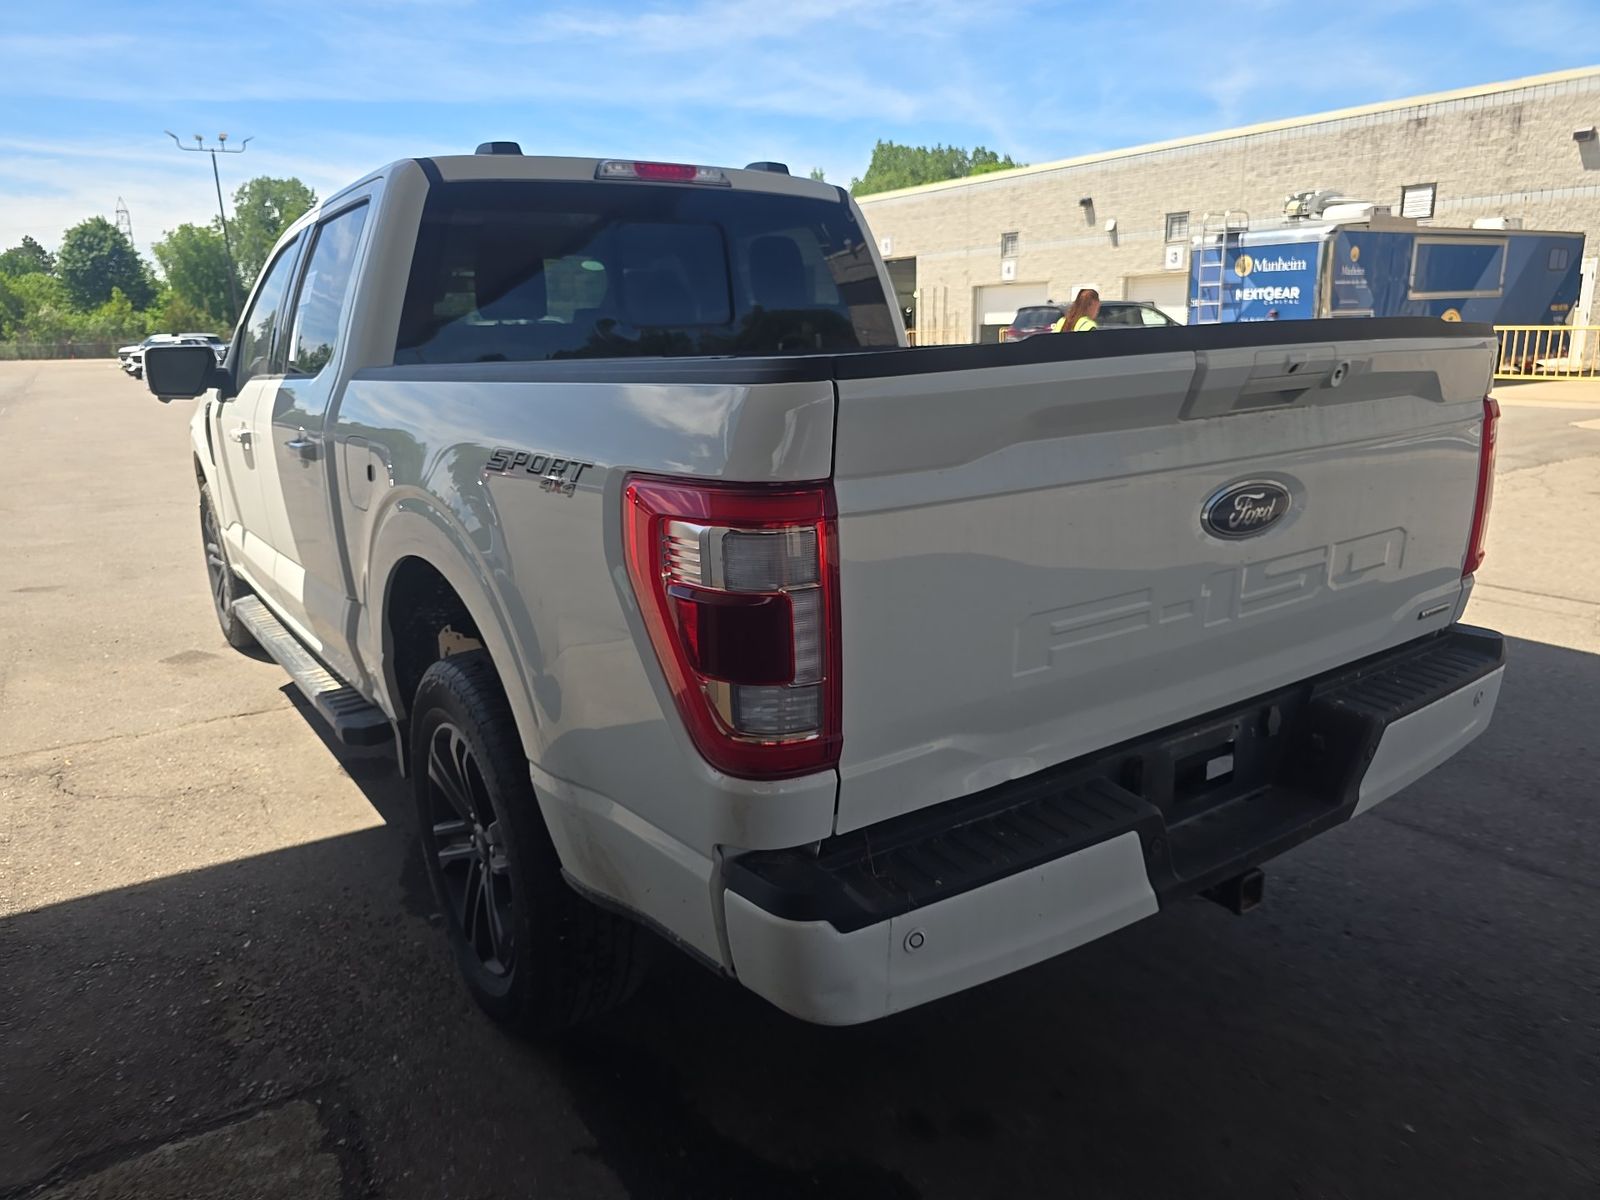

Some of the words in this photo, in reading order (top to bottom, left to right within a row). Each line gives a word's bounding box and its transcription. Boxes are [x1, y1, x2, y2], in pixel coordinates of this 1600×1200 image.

[1253, 256, 1306, 272] Manheim
[1235, 286, 1300, 301] NEXTGEAR
[486, 447, 593, 483] SPORT
[1229, 492, 1276, 528] Ford
[1012, 527, 1407, 677] F-150
